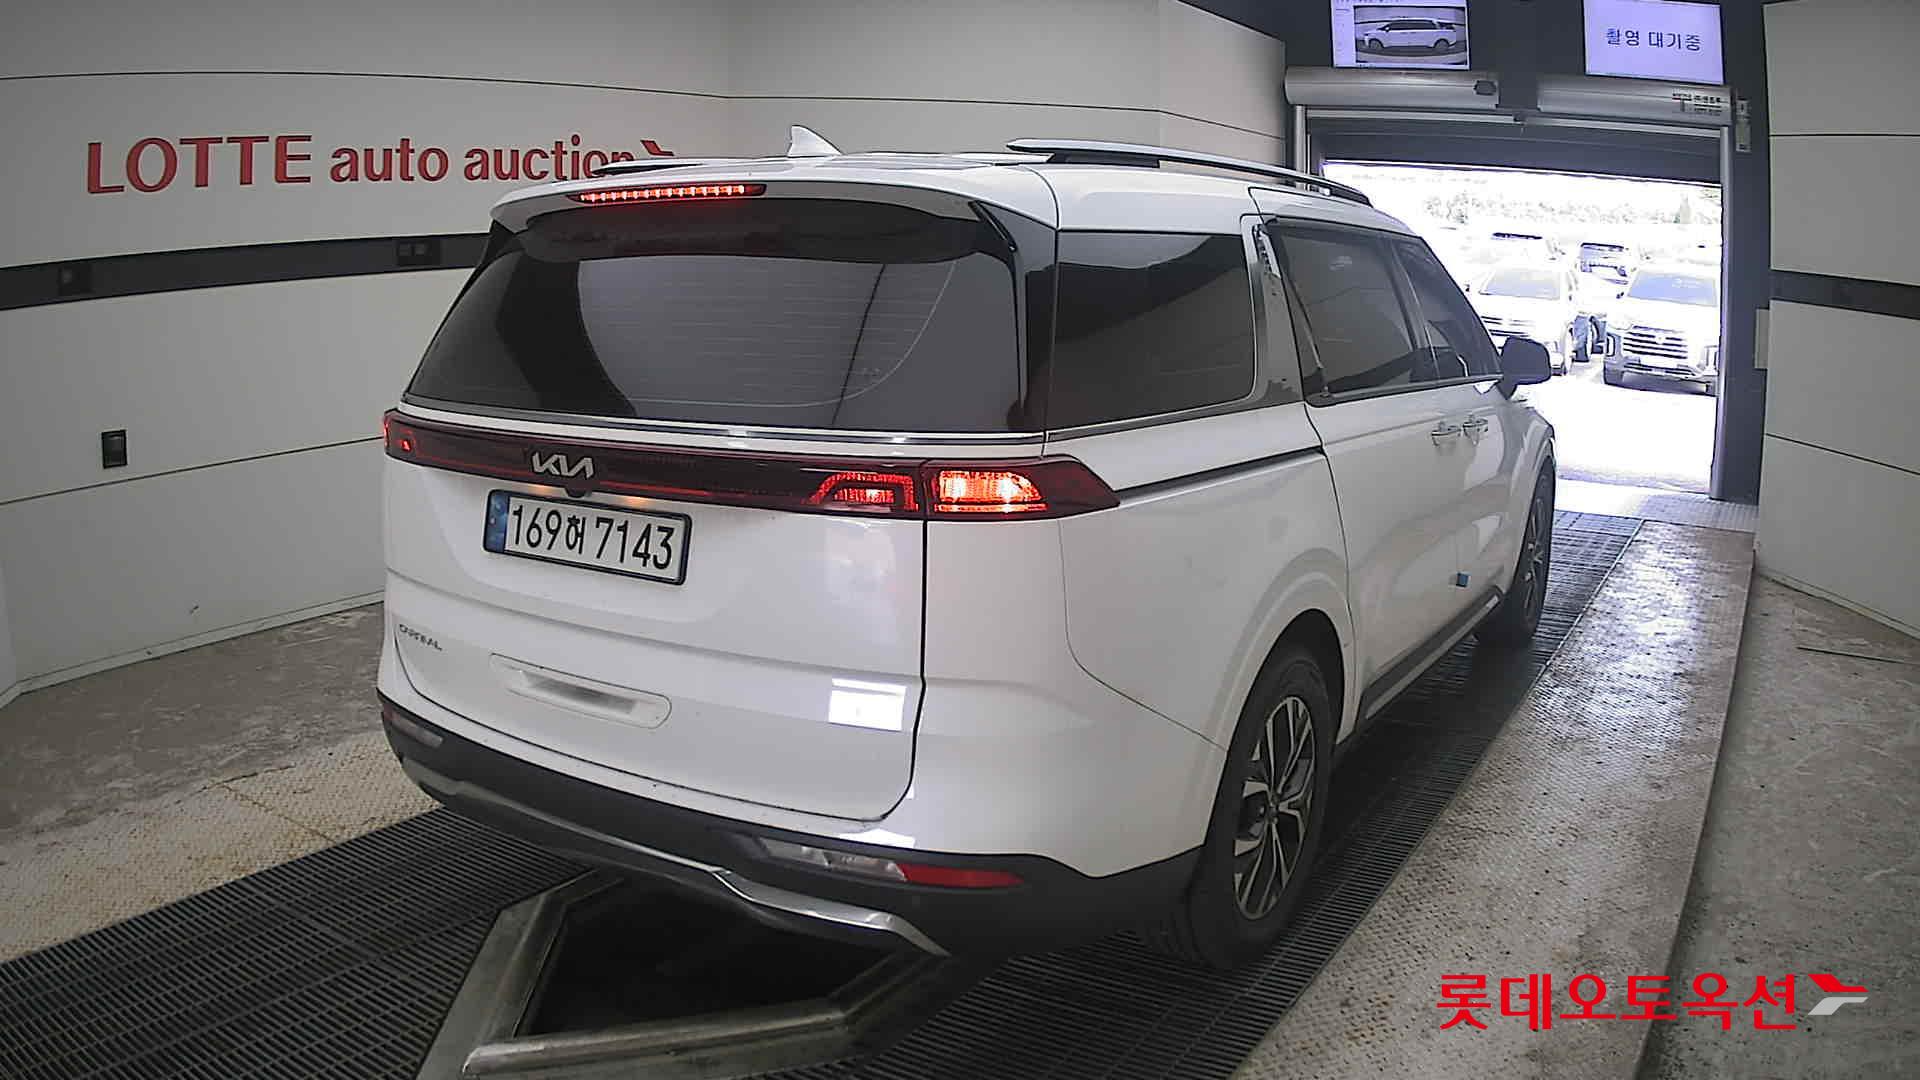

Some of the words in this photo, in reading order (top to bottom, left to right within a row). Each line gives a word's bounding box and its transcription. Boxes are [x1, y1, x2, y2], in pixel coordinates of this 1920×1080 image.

[1648, 31, 1701, 52] 대기중
[87, 135, 312, 194] LOTTE
[330, 138, 450, 182] auto
[595, 516, 675, 570] 7143
